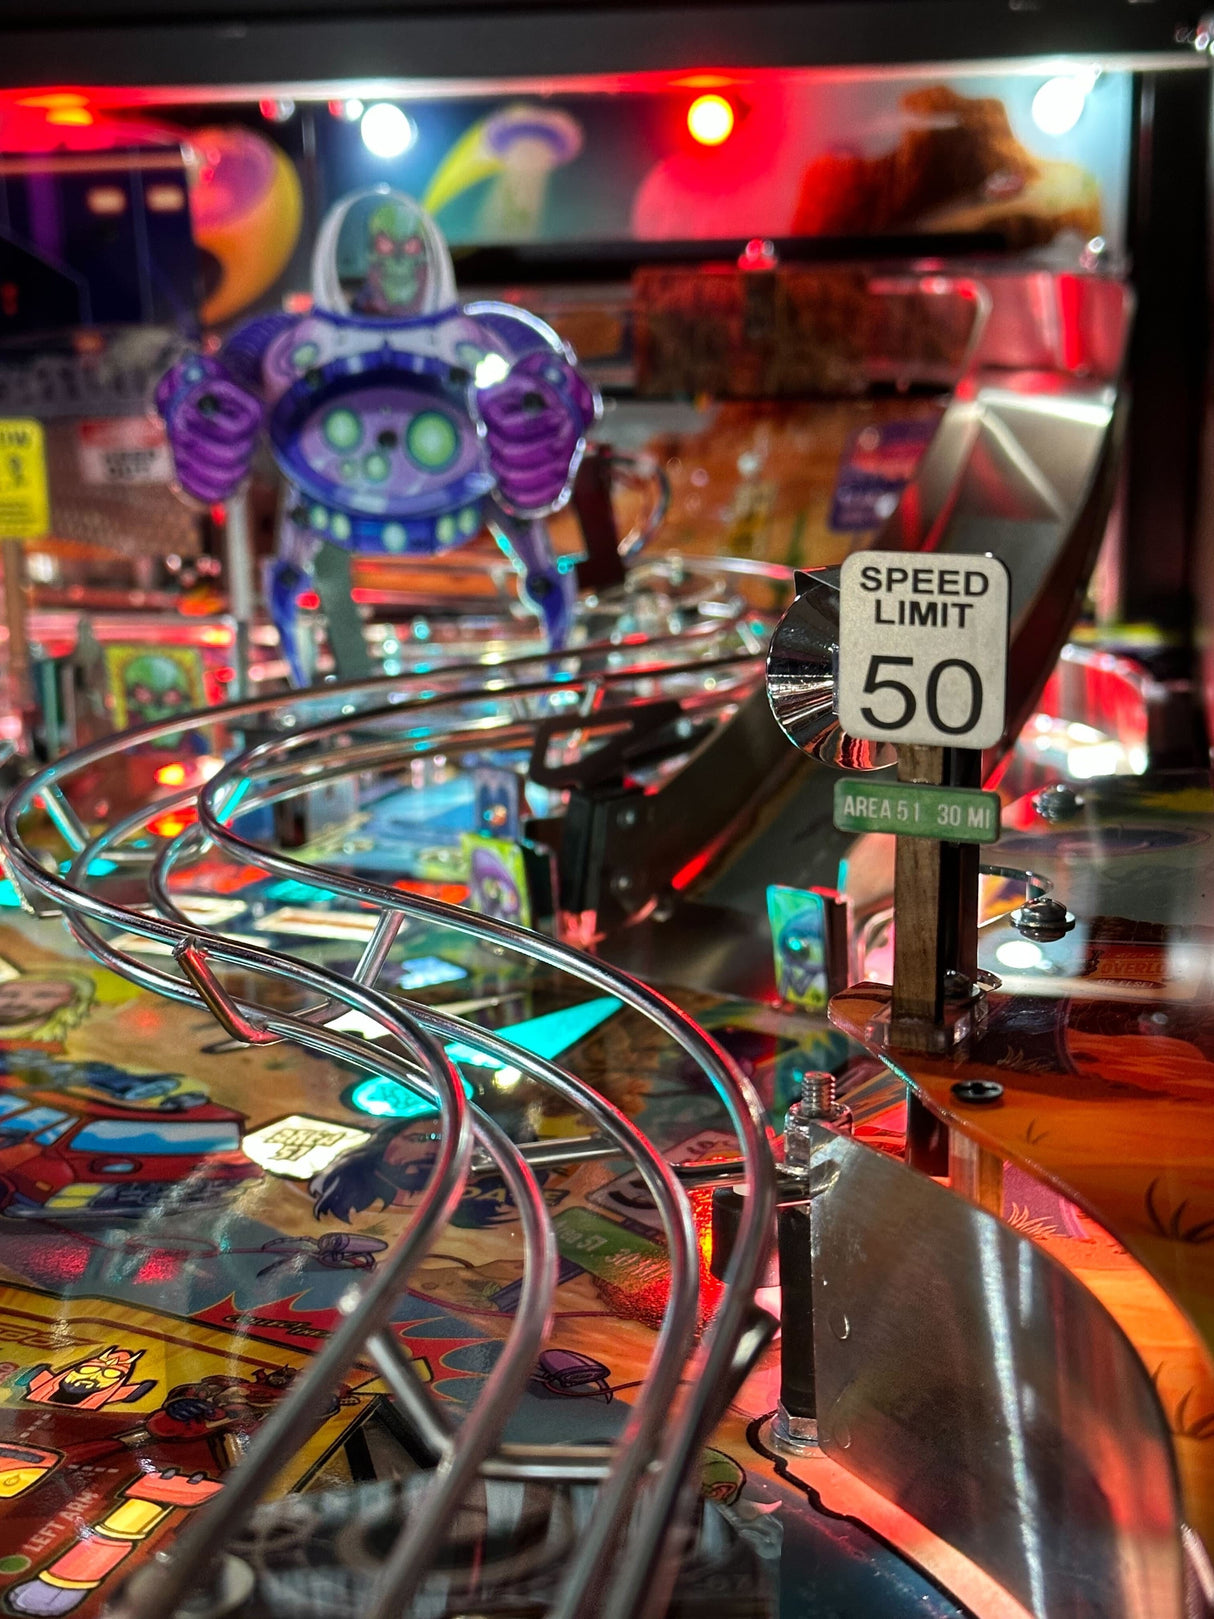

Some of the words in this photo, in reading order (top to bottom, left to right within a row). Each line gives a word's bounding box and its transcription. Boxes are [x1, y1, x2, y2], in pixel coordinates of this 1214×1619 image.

[860, 566, 989, 596] SPEED
[874, 599, 974, 628] LIMIT
[860, 655, 983, 735] 50
[843, 795, 891, 819] AREA
[897, 801, 919, 822] 51
[937, 804, 961, 826] 30
[968, 807, 990, 829] MI
[22, 1520, 65, 1552] LEFT
[59, 1490, 100, 1522] ARM
